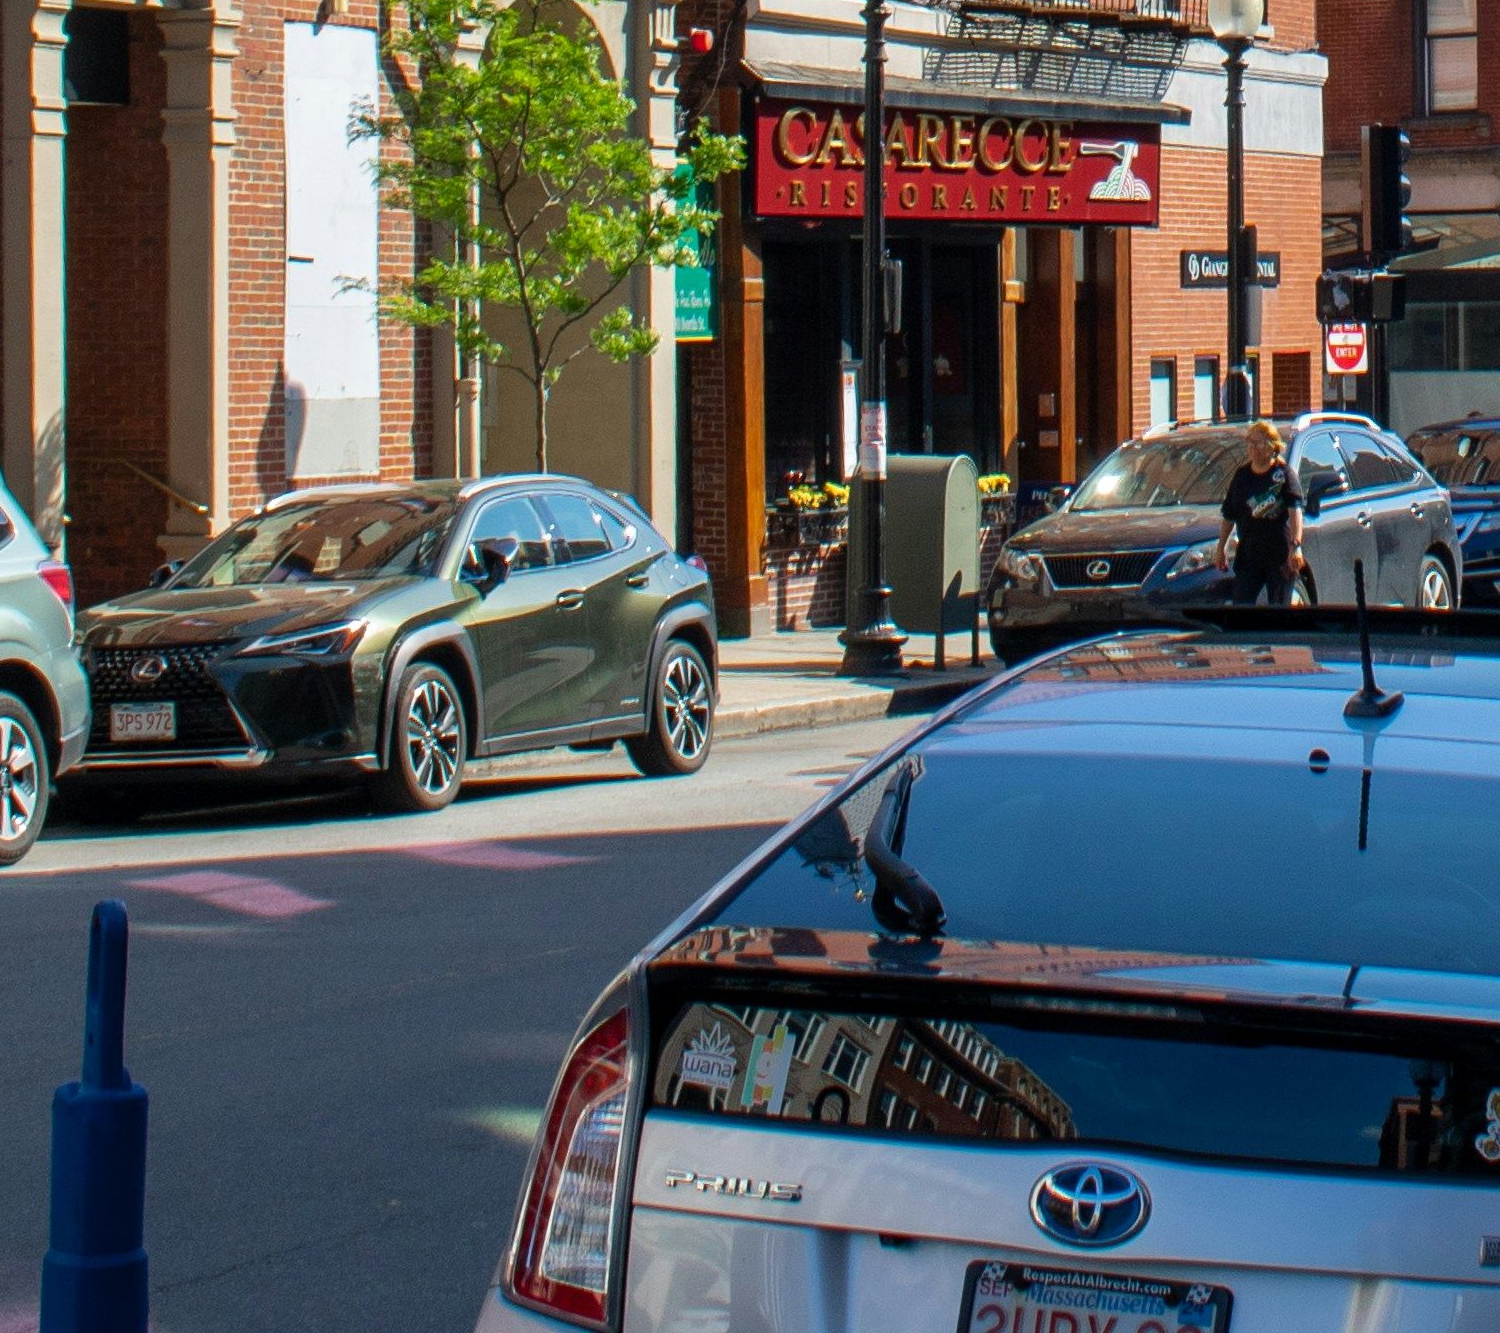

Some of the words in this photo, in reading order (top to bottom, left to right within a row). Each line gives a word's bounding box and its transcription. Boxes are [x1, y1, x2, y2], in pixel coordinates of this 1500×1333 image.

[789, 179, 1062, 211] RISORANTE
[1336, 348, 1357, 357] ENTER
[116, 713, 143, 731] 3PS
[146, 712, 172, 731] 972
[684, 1056, 733, 1079] wana
[664, 1168, 804, 1201] PRIUS
[1024, 1282, 1166, 1317] Massachusetts
